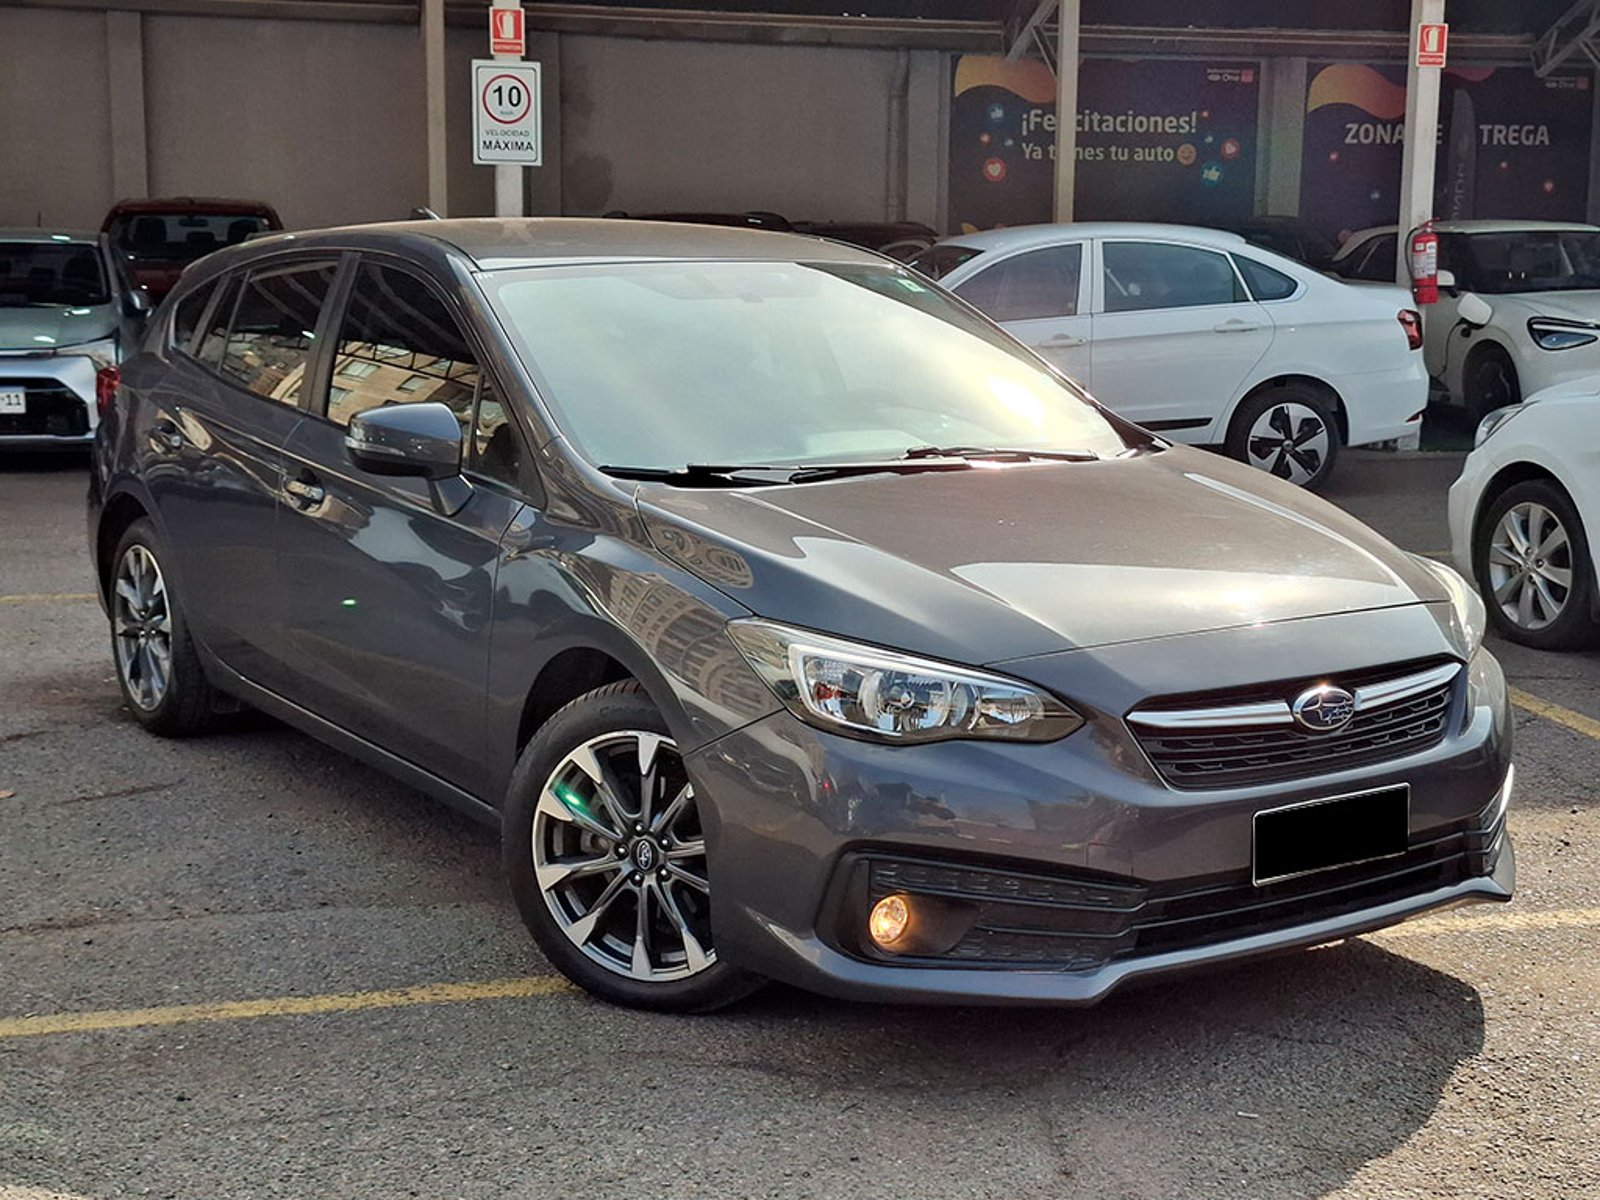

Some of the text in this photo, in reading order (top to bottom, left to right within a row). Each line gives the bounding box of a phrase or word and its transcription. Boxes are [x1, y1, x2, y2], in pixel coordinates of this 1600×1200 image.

[492, 85, 522, 107] 10
[483, 128, 531, 137] VELOCIDAD
[1021, 109, 1197, 137] ¡Fecitaciones!
[1345, 123, 1405, 145] ZONA
[1479, 124, 1550, 146] TREGA
[1021, 142, 1175, 162] Ya tnes tu auto
